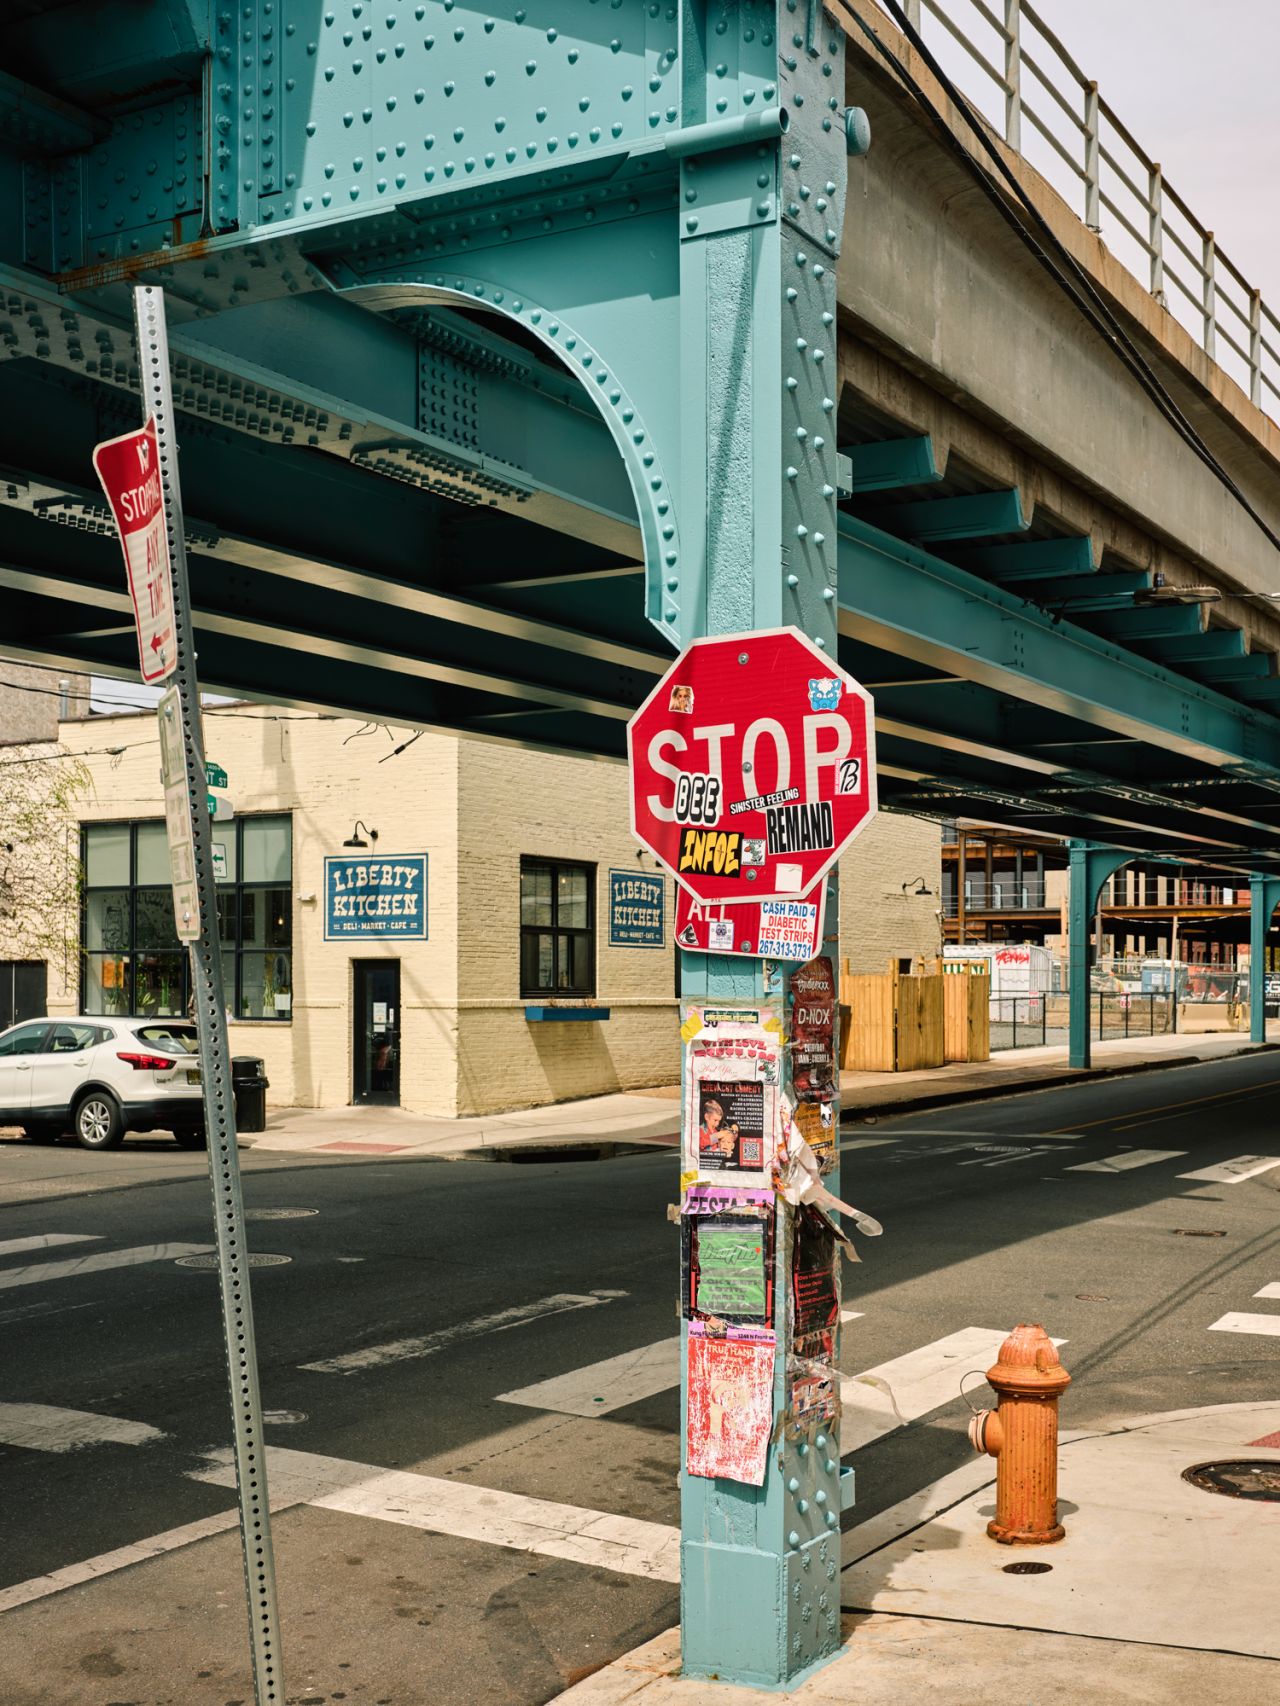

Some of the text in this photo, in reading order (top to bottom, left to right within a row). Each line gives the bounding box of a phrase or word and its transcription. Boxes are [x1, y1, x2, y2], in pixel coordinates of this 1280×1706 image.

[120, 468, 160, 522] STOPPING
[147, 573, 165, 618] TIME
[647, 713, 852, 822] STOP
[730, 788, 799, 815] SINISTER FEELING
[767, 802, 833, 854] REMAND
[333, 865, 419, 891] LIBERTY
[614, 881, 660, 904] LIBERTY
[333, 893, 418, 916] KITCHEN
[687, 900, 733, 923] ALL
[763, 902, 816, 918] CASH PAID 4
[361, 922, 386, 930] MARKET
[614, 906, 660, 927] KITCHEN
[768, 916, 807, 929] DIABETIC
[761, 928, 813, 943] TEST STRIPS
[759, 940, 812, 958] 267-313-3731
[797, 1008, 830, 1025] D-NOX
